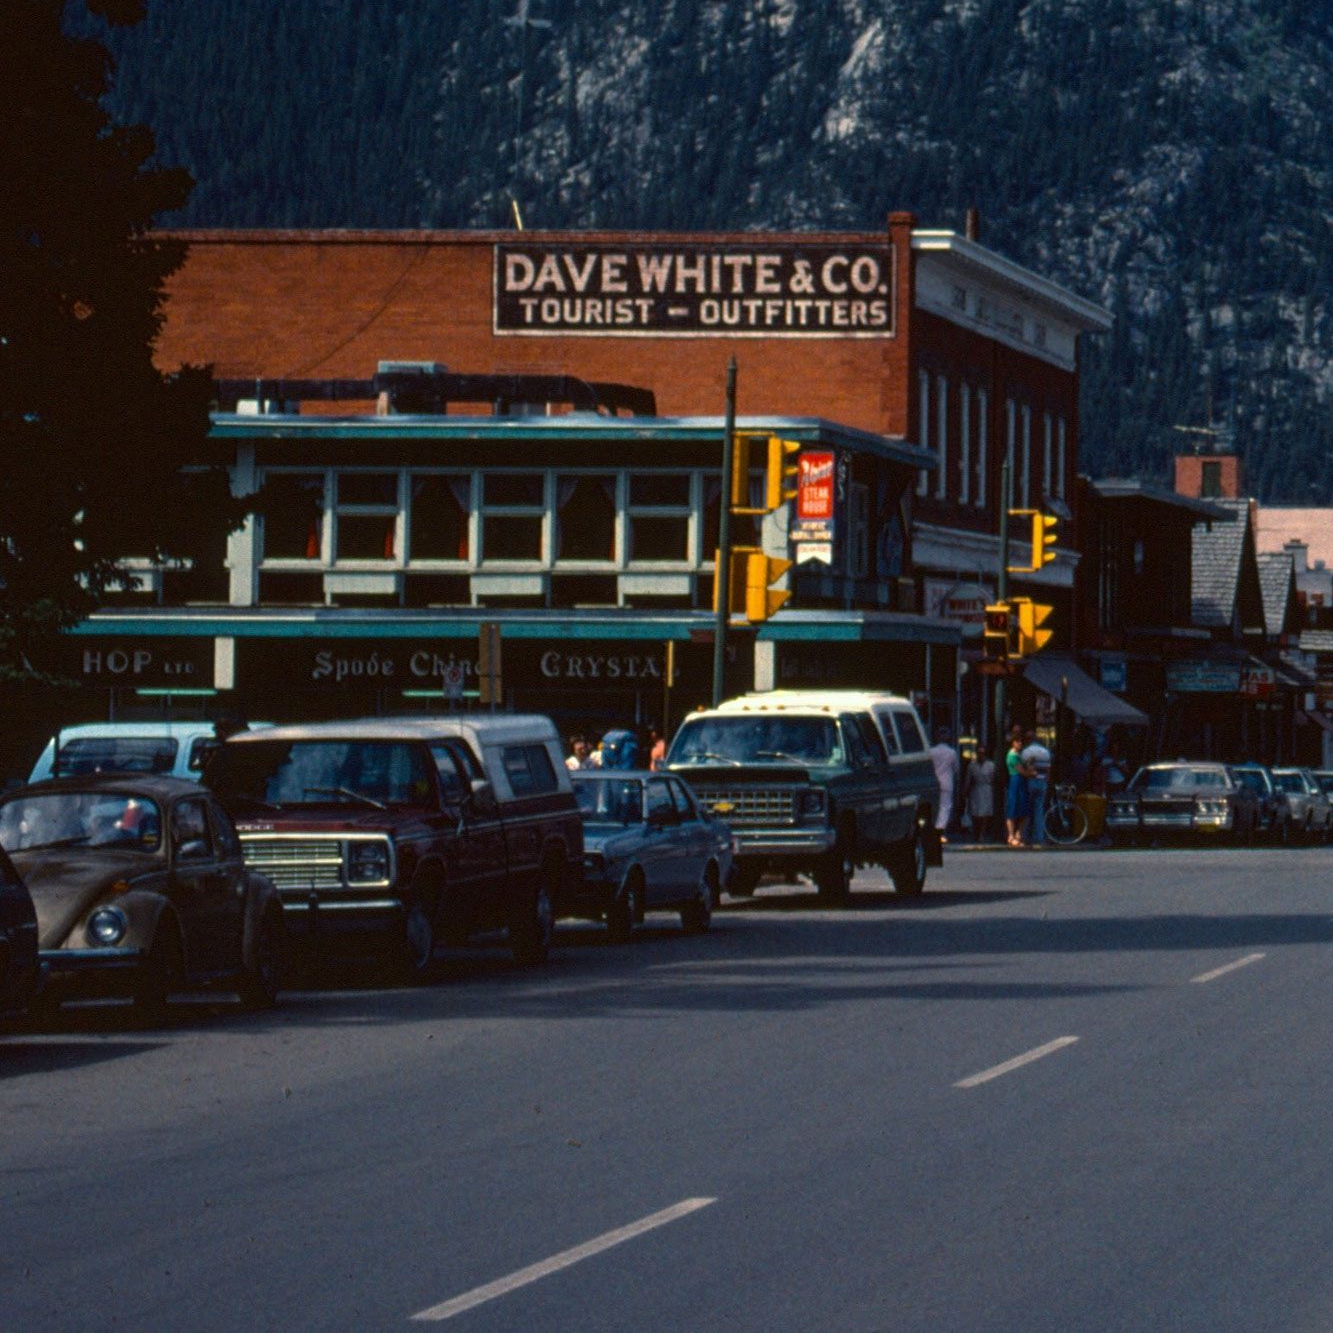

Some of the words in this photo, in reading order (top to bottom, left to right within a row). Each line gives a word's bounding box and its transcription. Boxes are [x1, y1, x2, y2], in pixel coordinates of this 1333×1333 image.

[505, 254, 628, 292] DAVE
[637, 255, 781, 293] WHITE
[789, 260, 815, 293] &
[822, 256, 889, 294] CO.
[519, 298, 655, 324] TOURIST
[700, 299, 887, 325] OUTFITTERS
[312, 651, 394, 682] Spode
